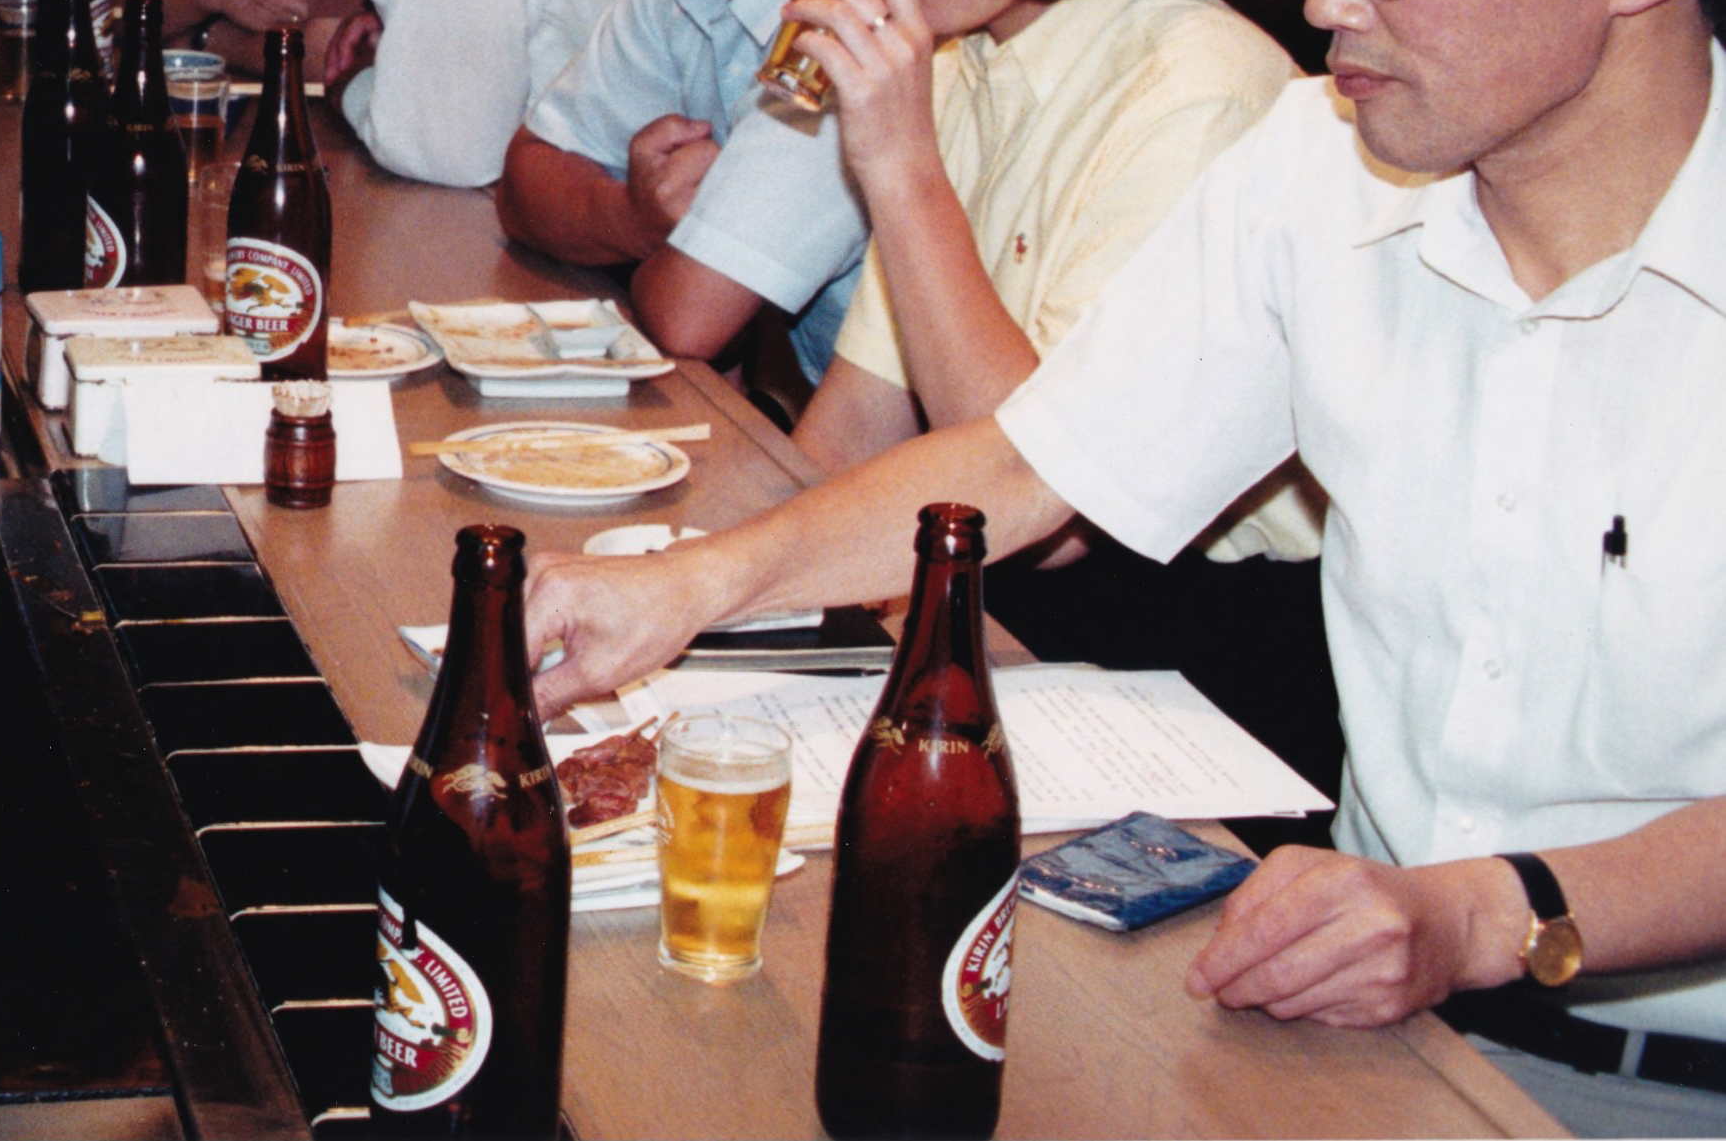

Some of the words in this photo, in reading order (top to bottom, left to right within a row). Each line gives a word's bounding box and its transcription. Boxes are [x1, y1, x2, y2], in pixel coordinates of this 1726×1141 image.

[290, 266, 313, 296] LIMITED
[256, 318, 289, 331] BEER
[918, 738, 970, 755] KIRIN
[966, 929, 995, 973] KIRIN
[424, 959, 468, 1019] LIMITED
[379, 1032, 418, 1068] BEER
